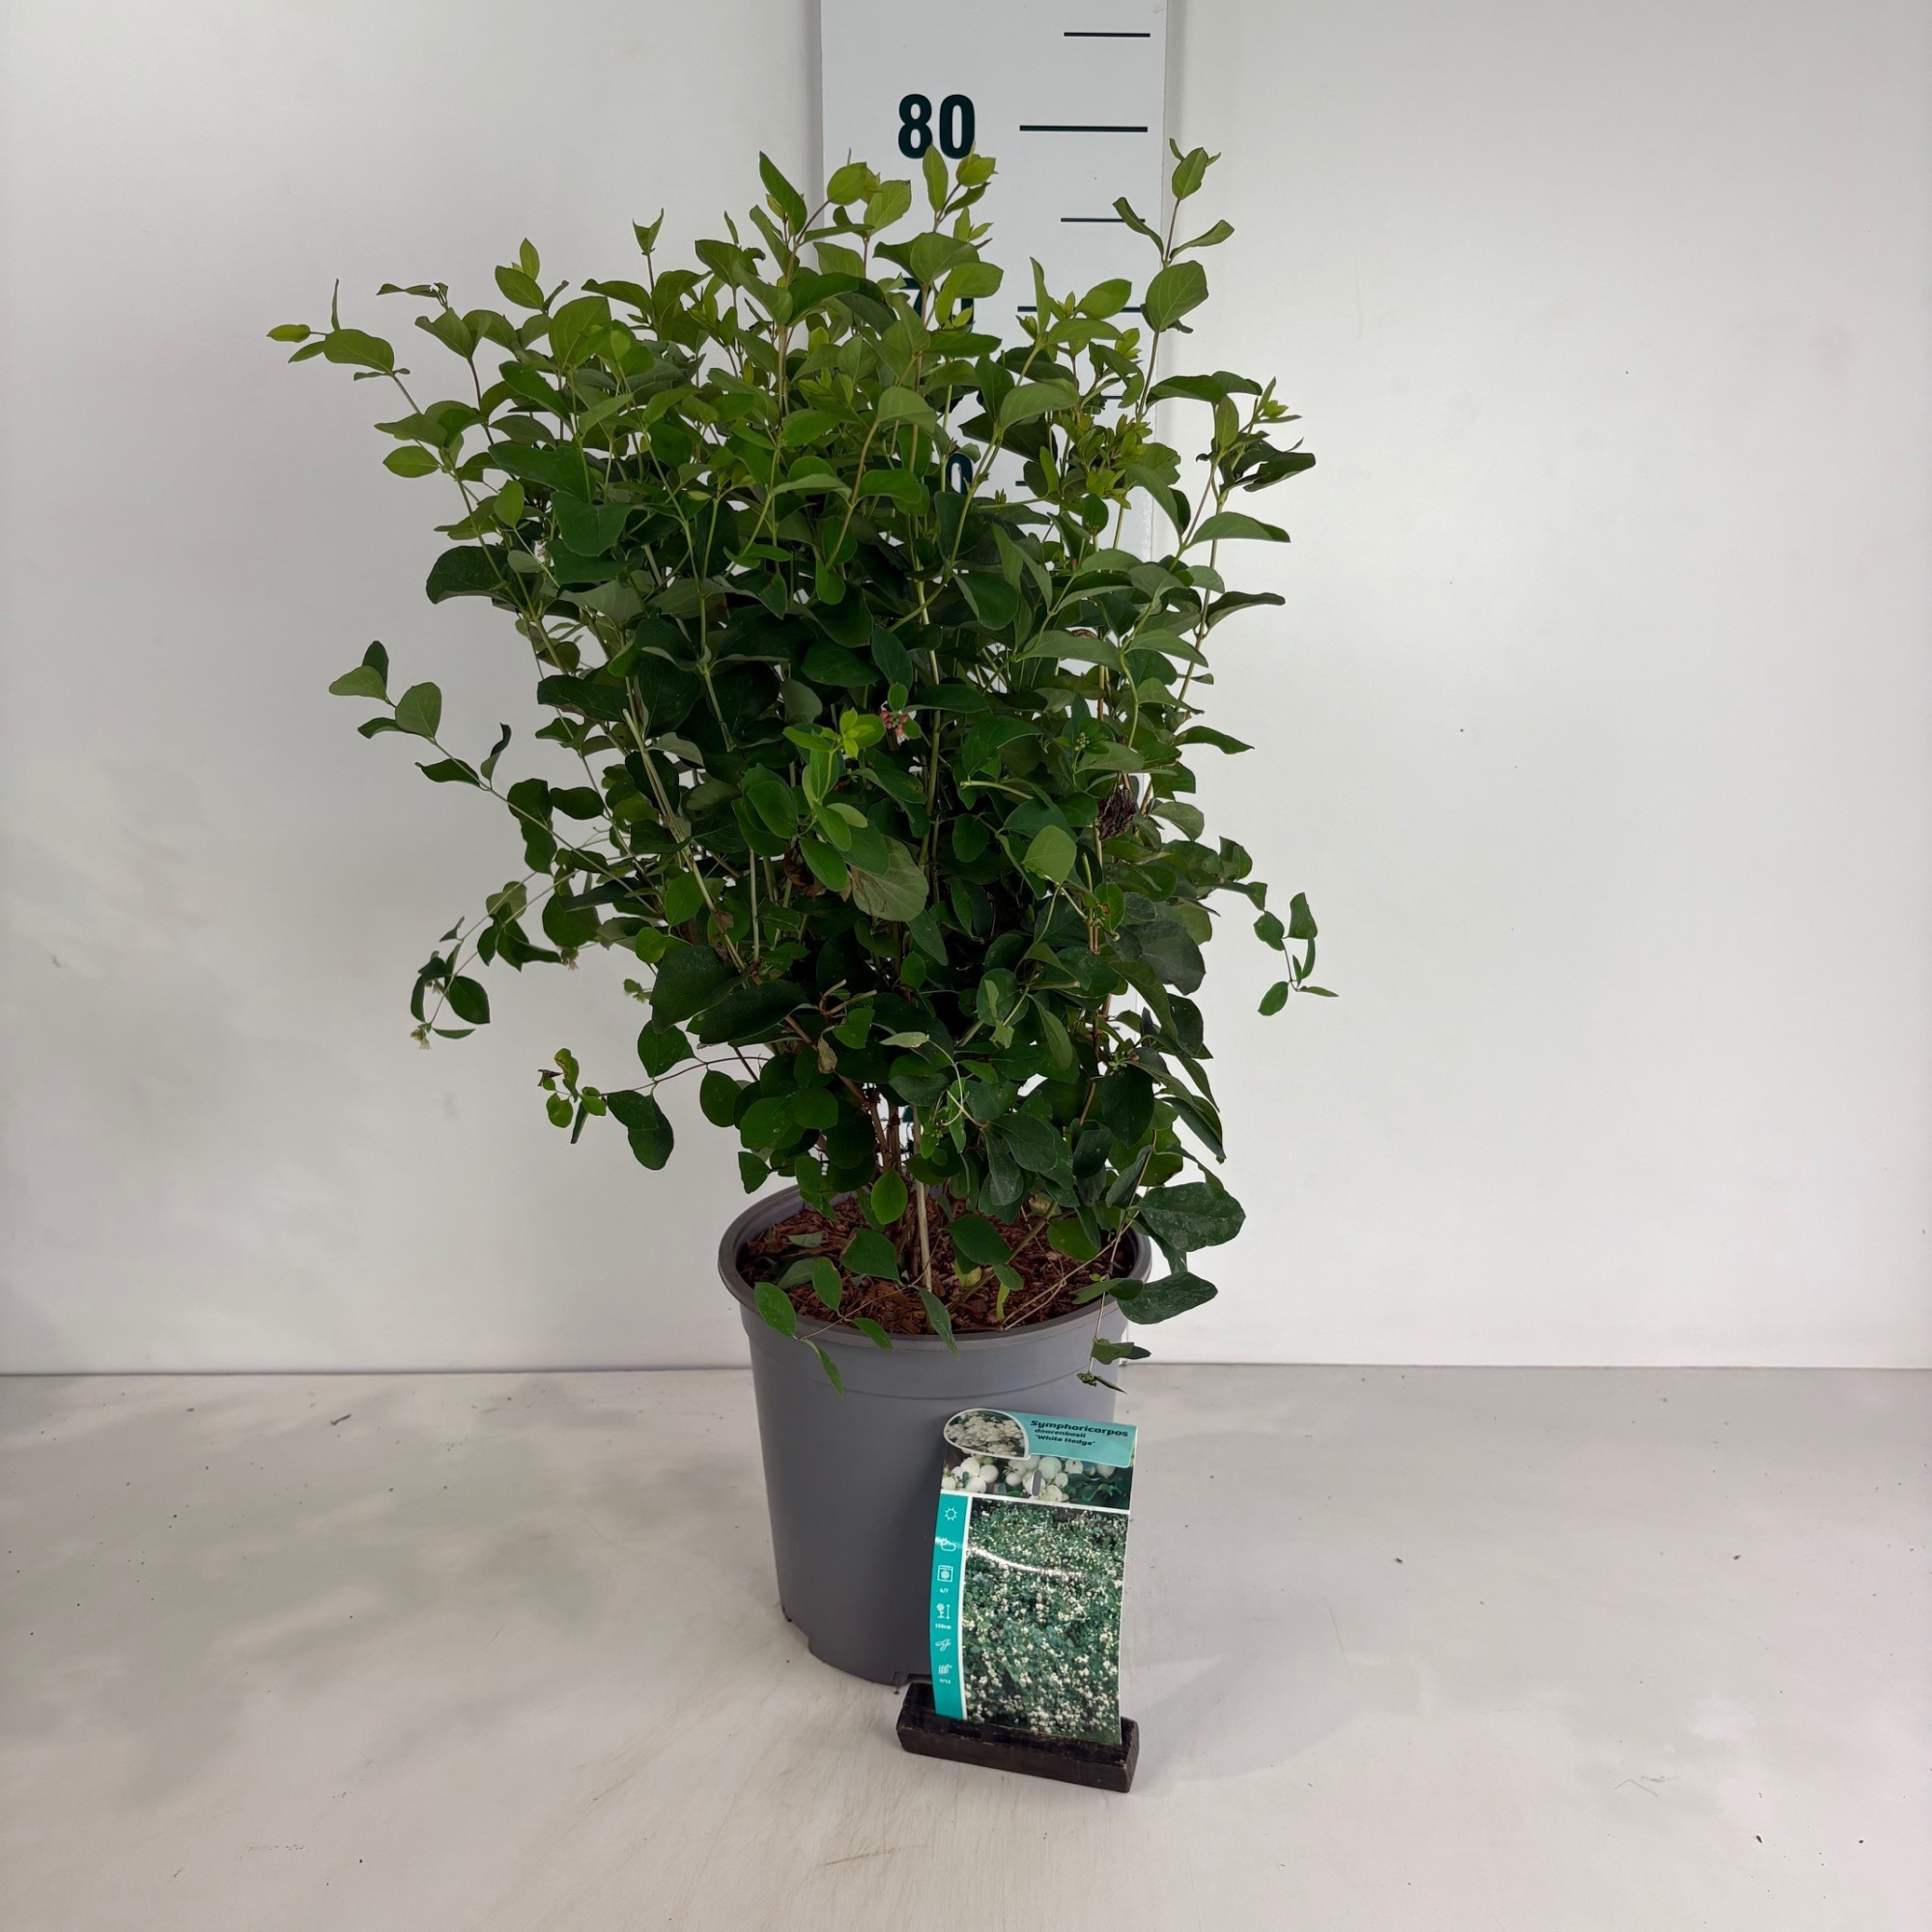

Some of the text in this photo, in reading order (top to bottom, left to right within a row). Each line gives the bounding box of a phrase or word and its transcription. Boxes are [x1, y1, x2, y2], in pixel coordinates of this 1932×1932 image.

[897, 94, 975, 159] 80
[1030, 1420, 1128, 1436] Symphoricarpos
[1035, 1429, 1086, 1437] doorenbosii
